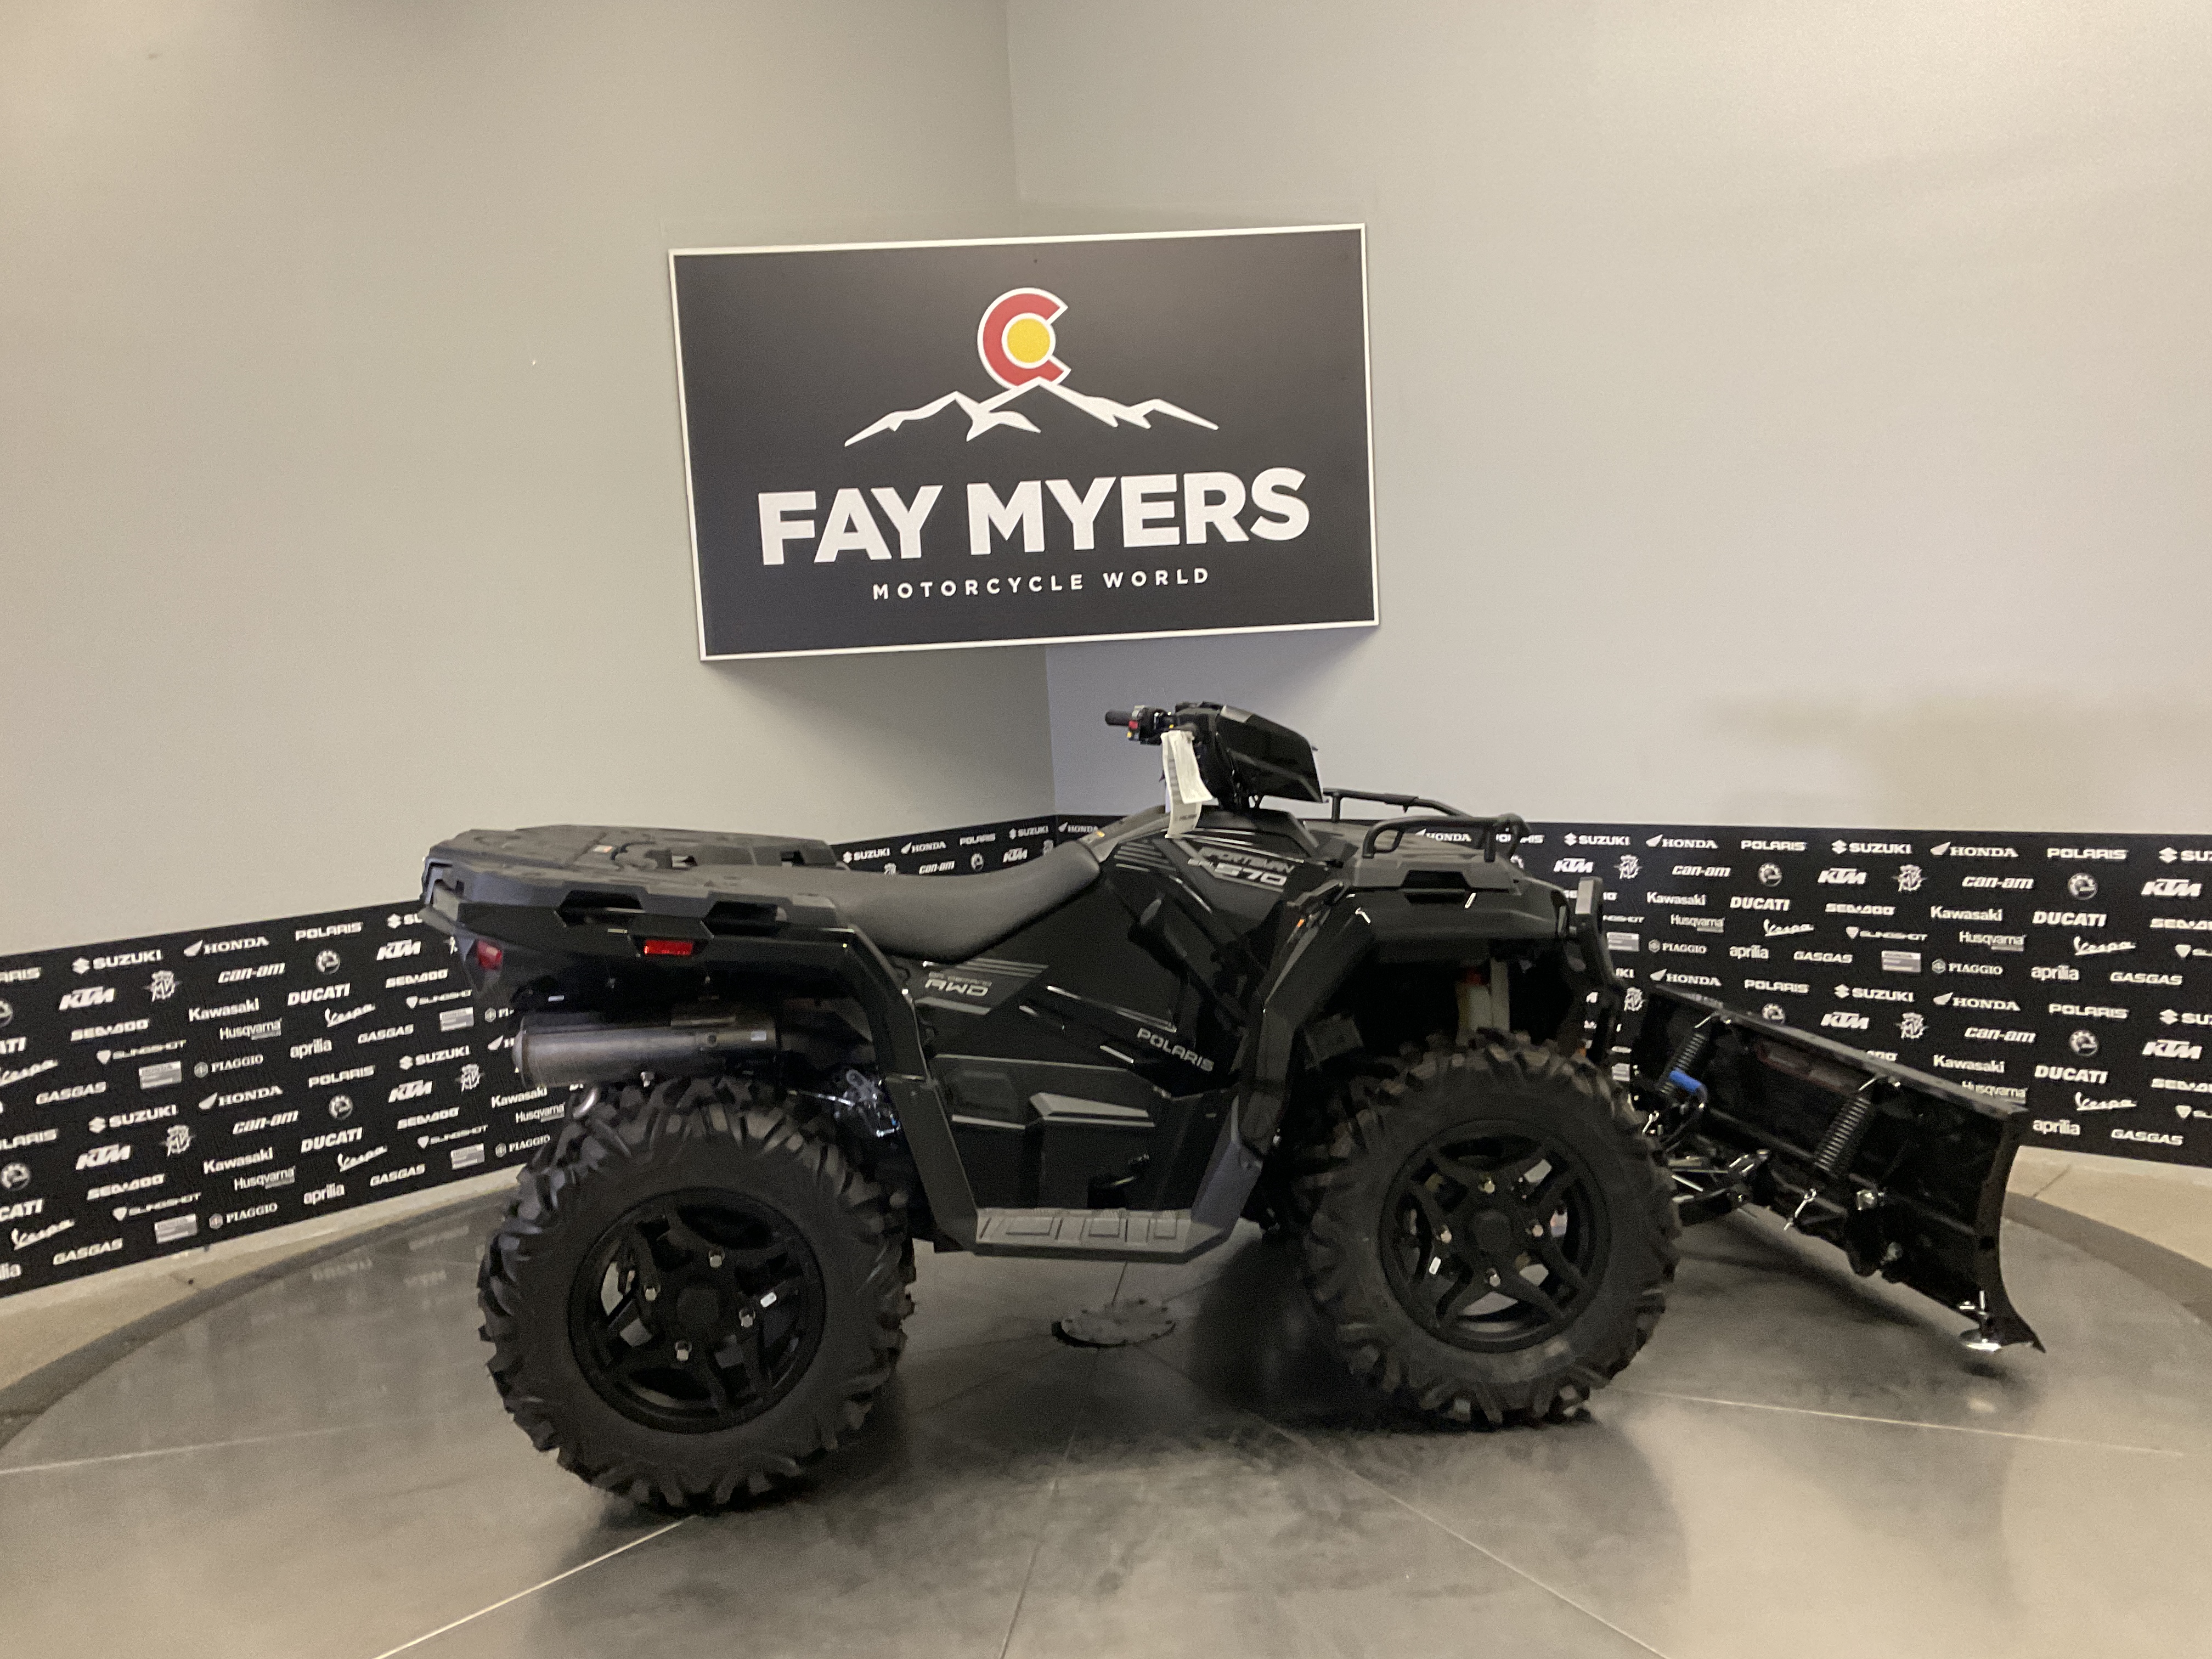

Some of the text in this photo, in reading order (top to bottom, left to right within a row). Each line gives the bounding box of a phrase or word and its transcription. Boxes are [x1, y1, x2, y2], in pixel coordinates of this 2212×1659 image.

[758, 467, 1310, 566] FAY MYERS
[873, 568, 1208, 600] MOTORCYCLE WORLD
[1018, 825, 1048, 837] SUZUKI
[1578, 835, 1630, 846] SUZUKI
[911, 841, 946, 853] HONDA
[1662, 838, 1718, 849] HONDA
[1741, 840, 1807, 851] POLARIS
[1849, 842, 1912, 854] SUZUKI
[1949, 846, 2019, 857] HONDA
[853, 847, 890, 861] SUZUKI
[1002, 848, 1028, 863] KTM
[2047, 848, 2129, 860] POLARIS
[1553, 857, 1594, 873] KTM
[1672, 865, 1731, 877] can-am
[1817, 867, 1867, 885] KTM
[1961, 876, 2034, 889] can-am
[2141, 878, 2202, 897] KTM
[1646, 891, 1706, 906] Kawasaki
[1729, 896, 1791, 911] DUCATI
[1671, 913, 1725, 928] Husqvarna
[1931, 906, 2003, 922] Kawasaki
[2032, 911, 2107, 927] DUCATI
[295, 922, 362, 941] POLARIS
[1763, 918, 1814, 937] Vespa
[204, 936, 270, 955] HONDA
[1959, 930, 2026, 946] Husqvarna
[2073, 935, 2136, 956] Vespa
[376, 939, 421, 961] KTM
[1662, 942, 1707, 954] PIAGGIO
[1729, 944, 1769, 960] aprilia
[1793, 951, 1853, 963] GASGAS
[93, 949, 162, 970] SUZUKI
[1948, 963, 2004, 975] PIAGGIO
[0, 967, 42, 983] ARIS
[218, 962, 285, 984] can-am
[1666, 973, 1722, 986] HONDA
[2031, 964, 2079, 981] aprilia
[2109, 972, 2183, 985] GASGAS
[287, 983, 351, 1006] DUCATI
[924, 978, 989, 996] AWD
[1744, 979, 1810, 994] POLARIS
[1852, 988, 1915, 1002] SUZUKI
[58, 986, 115, 1011] KTM
[1953, 997, 2021, 1011] HONDA
[188, 997, 259, 1022] Kawasaki
[324, 1003, 376, 1028] Vespa
[2049, 1003, 2129, 1019] POLARIS
[219, 1018, 282, 1041] Husqvarna
[1820, 1011, 1870, 1030] KTM
[357, 1024, 414, 1044] GASGAS
[1964, 1027, 2036, 1043] can-am
[290, 1037, 332, 1059] aprilia
[415, 1045, 471, 1066] SUZUKI
[1136, 1027, 1215, 1072] POLARIS
[2141, 1039, 2203, 1059] KTM
[0, 1059, 58, 1087] espa
[211, 1054, 264, 1073] PIAGGIO
[1933, 1054, 2005, 1074] Kawasaki
[308, 1065, 375, 1088] POLARIS
[2034, 1065, 2108, 1085] DUCATI
[36, 1081, 106, 1105] GASGAS
[218, 1085, 283, 1107] HONDA
[388, 1079, 433, 1103] KTM
[491, 1086, 548, 1109] Kawasaki
[2074, 1091, 2137, 1111] Vespa
[109, 1104, 179, 1128] SUZUKI
[232, 1110, 299, 1135] can-am
[515, 1102, 566, 1124] Husqvarna
[2032, 1119, 2080, 1136] aprilia
[2111, 1128, 2184, 1146] GASGAS
[0, 1128, 58, 1151] LARIS
[301, 1126, 363, 1153] DUCATI
[509, 1134, 551, 1153] PIAGGIO
[75, 1143, 131, 1170] KTM
[203, 1146, 273, 1175] Kawasaki
[337, 1146, 388, 1172] Vespa
[234, 1165, 296, 1191] Husqvarna
[370, 1164, 425, 1187] GASGAS
[303, 1182, 345, 1205] aprilia
[0, 1198, 43, 1222] CATI
[226, 1202, 278, 1224] PIAGGIO
[11, 1219, 75, 1250] Vespa
[53, 1238, 123, 1266] GASGAS
